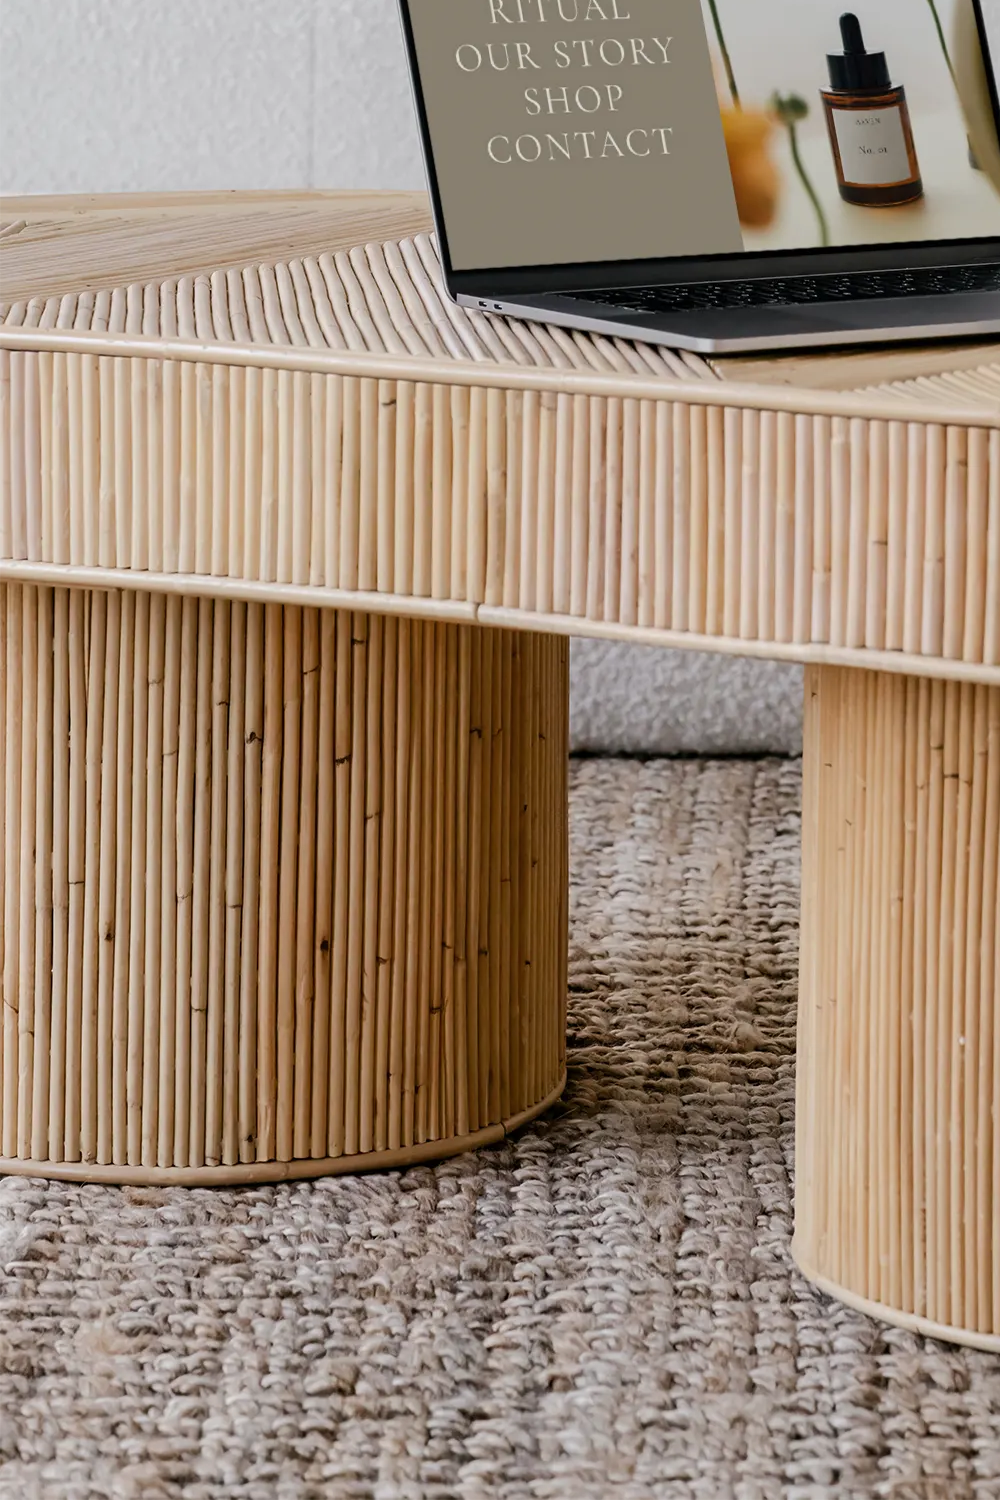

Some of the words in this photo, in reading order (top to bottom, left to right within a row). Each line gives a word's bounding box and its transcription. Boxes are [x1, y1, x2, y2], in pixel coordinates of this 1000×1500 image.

[455, 41, 542, 72] OUR
[553, 36, 674, 69] STORY
[524, 84, 624, 116] SHOP
[487, 127, 674, 164] CONTACT
